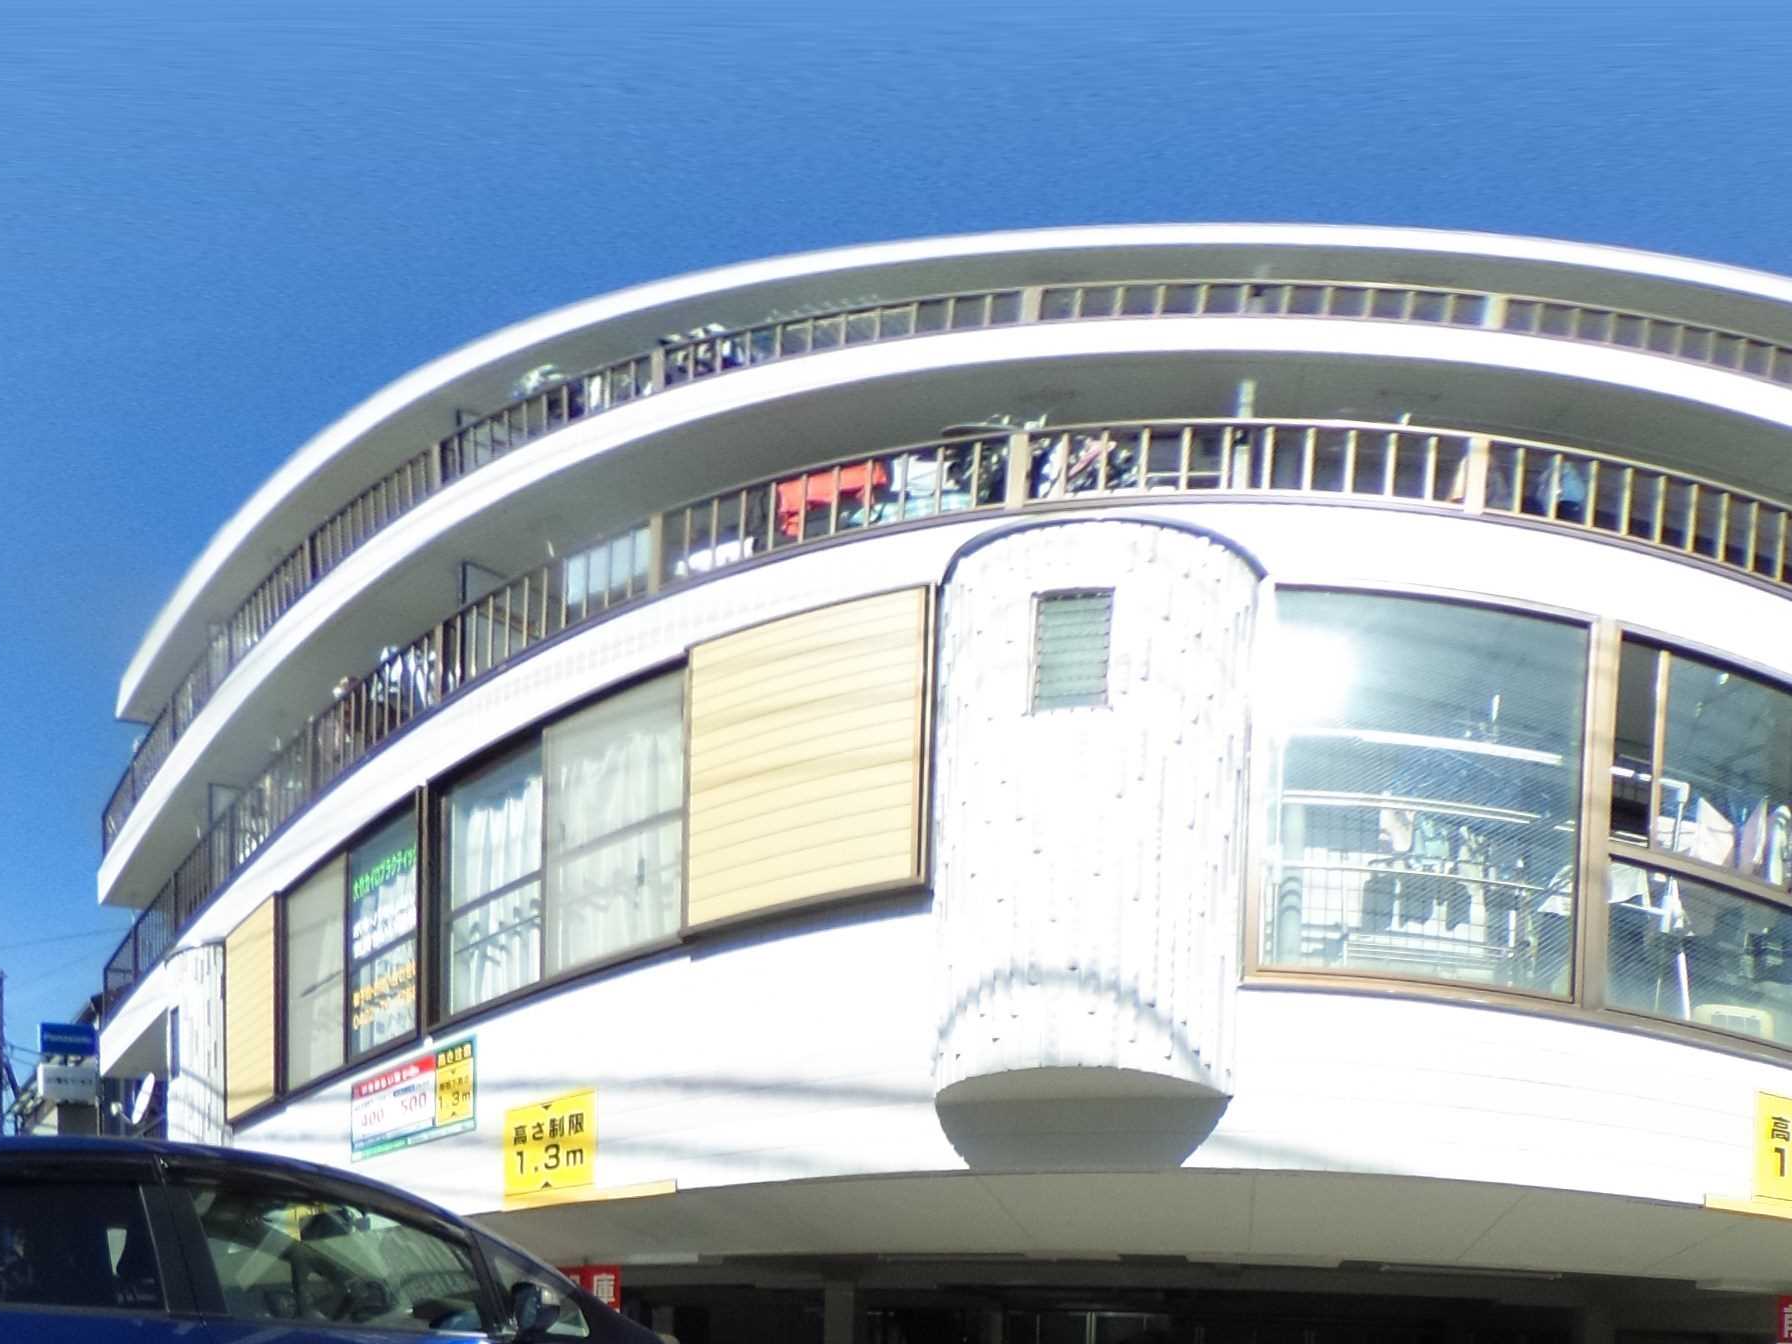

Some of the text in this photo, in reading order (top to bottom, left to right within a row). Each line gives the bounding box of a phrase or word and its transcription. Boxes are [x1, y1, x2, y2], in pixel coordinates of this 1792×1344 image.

[513, 1112, 584, 1146] 高さ制限
[516, 1143, 583, 1174] 1.3m
